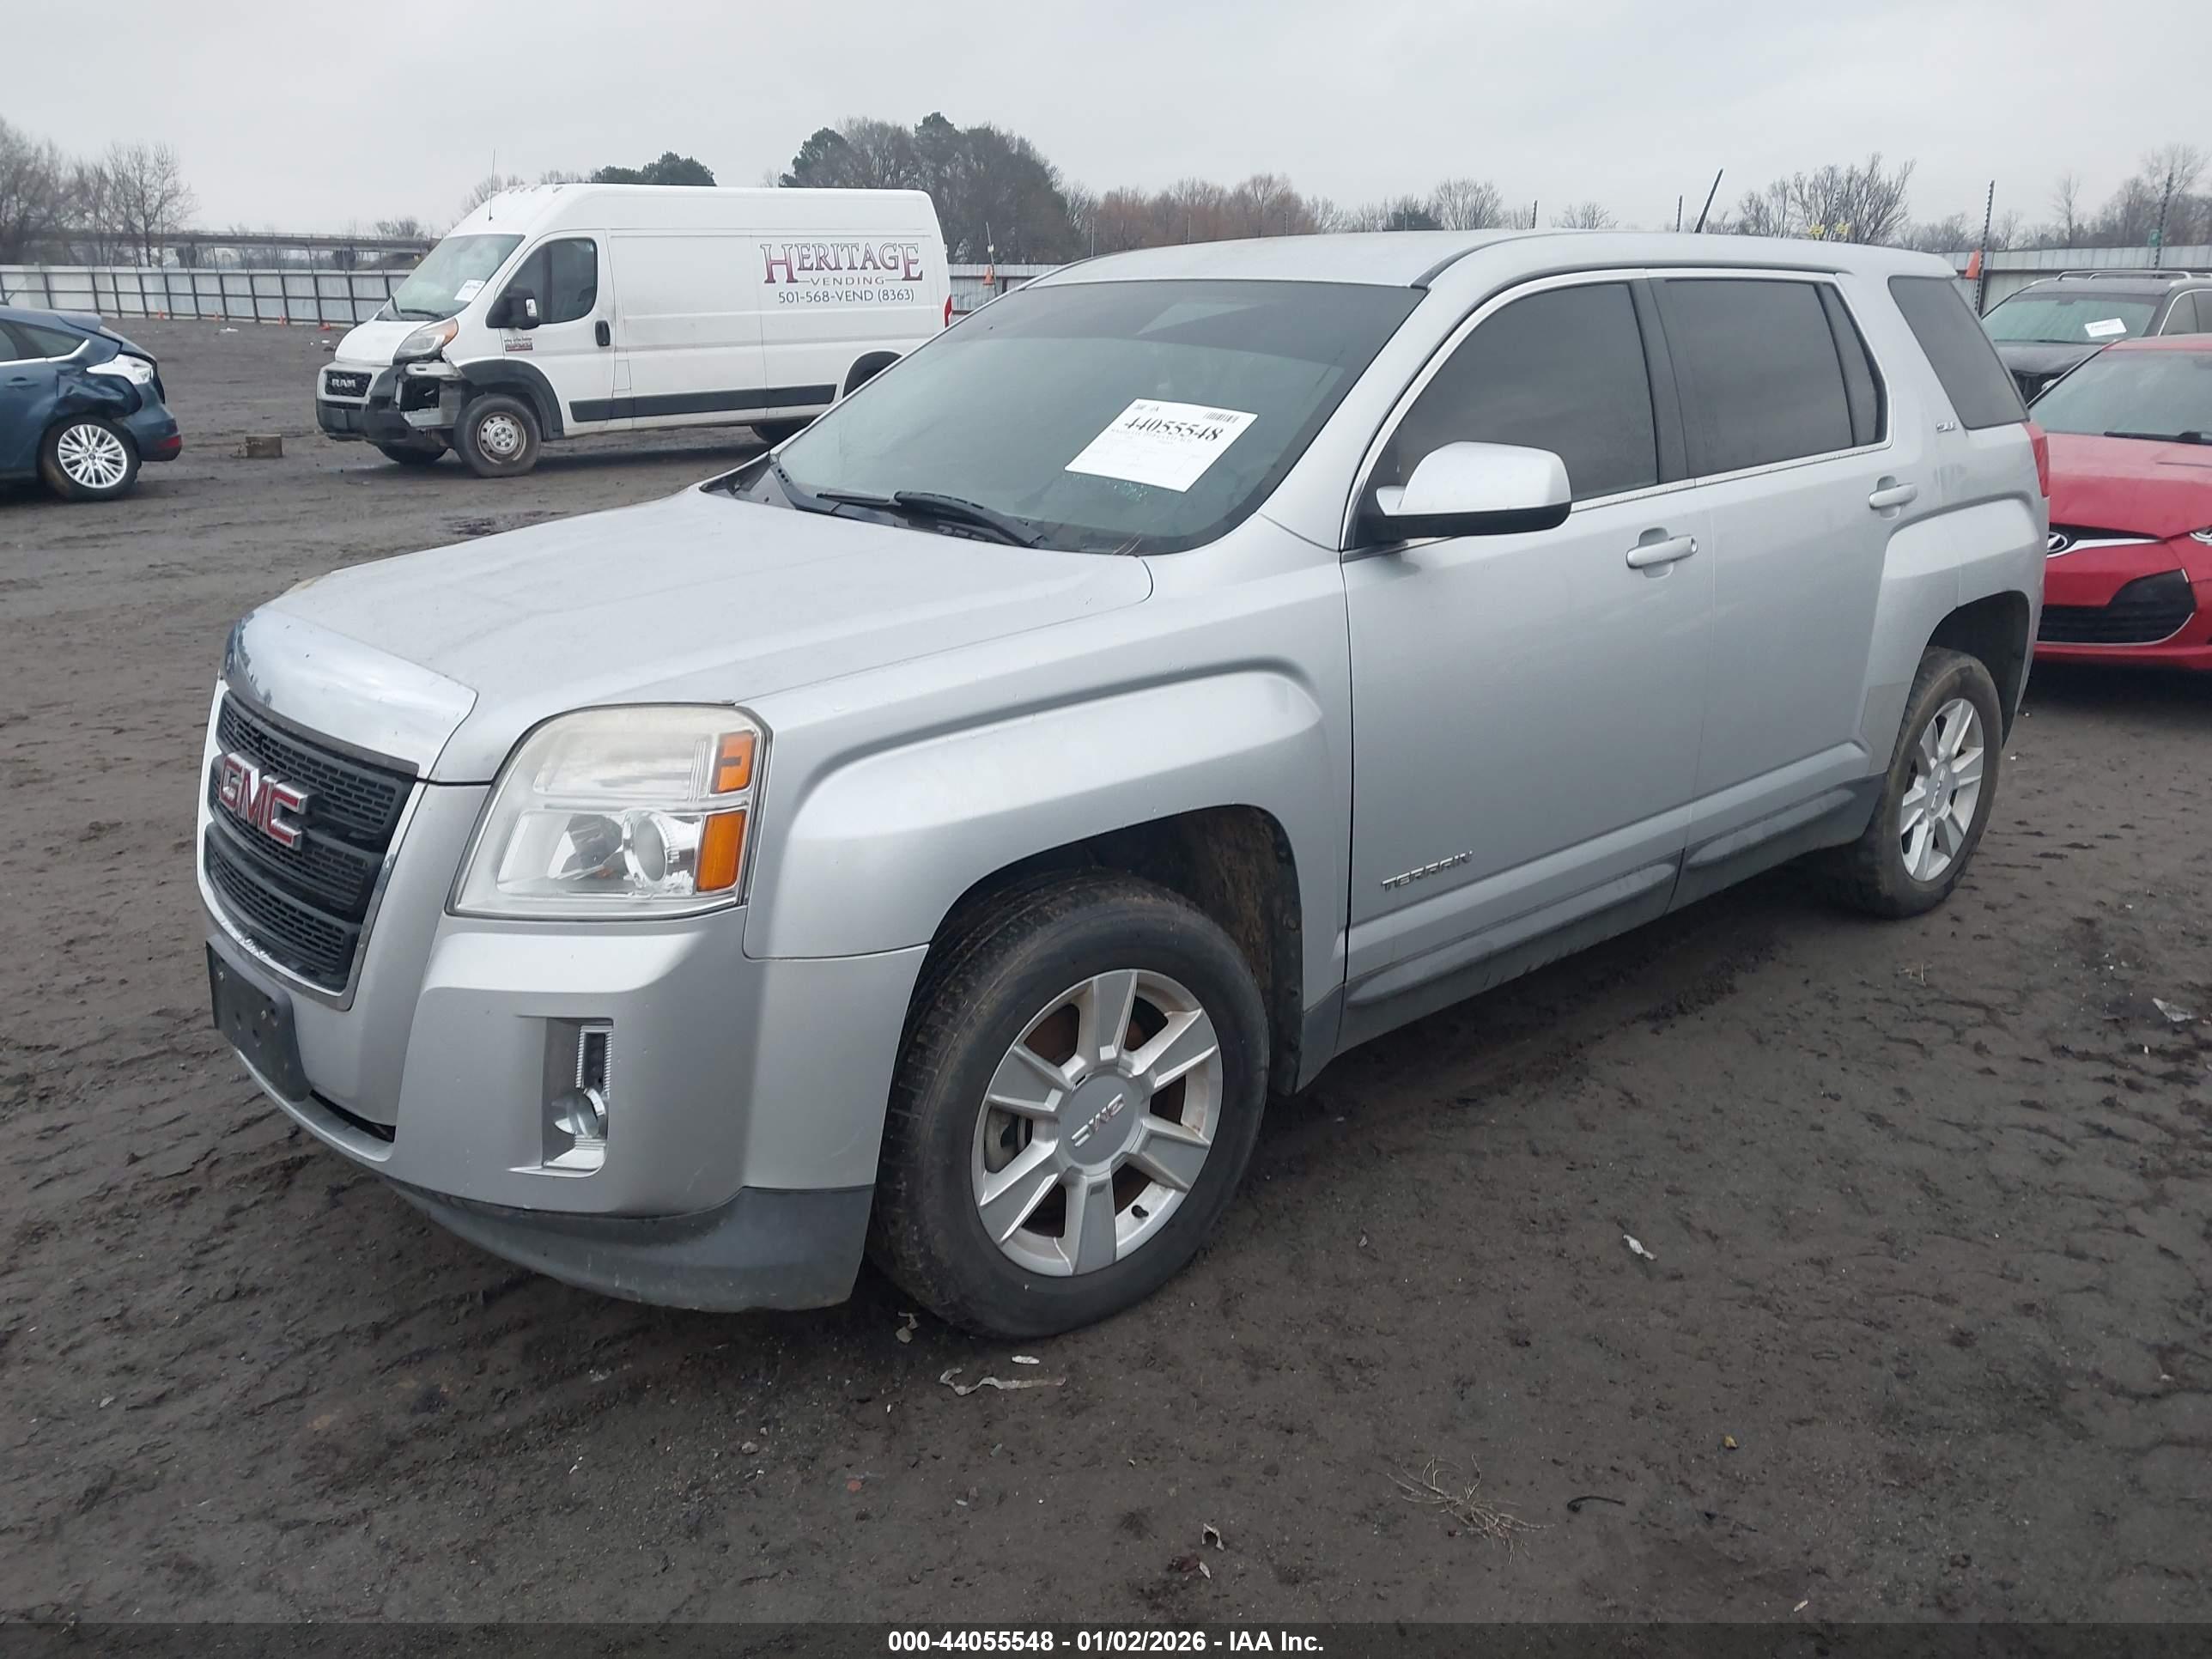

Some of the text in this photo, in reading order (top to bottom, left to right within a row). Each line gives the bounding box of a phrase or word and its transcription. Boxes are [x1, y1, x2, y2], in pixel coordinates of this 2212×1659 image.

[759, 242, 924, 284] HERITAGE
[810, 276, 885, 286] VENDING
[778, 288, 915, 304] 501-568-VEND (8363)
[331, 378, 356, 388] RAM
[1124, 416, 1224, 441] 44055548
[219, 753, 307, 850] GMC
